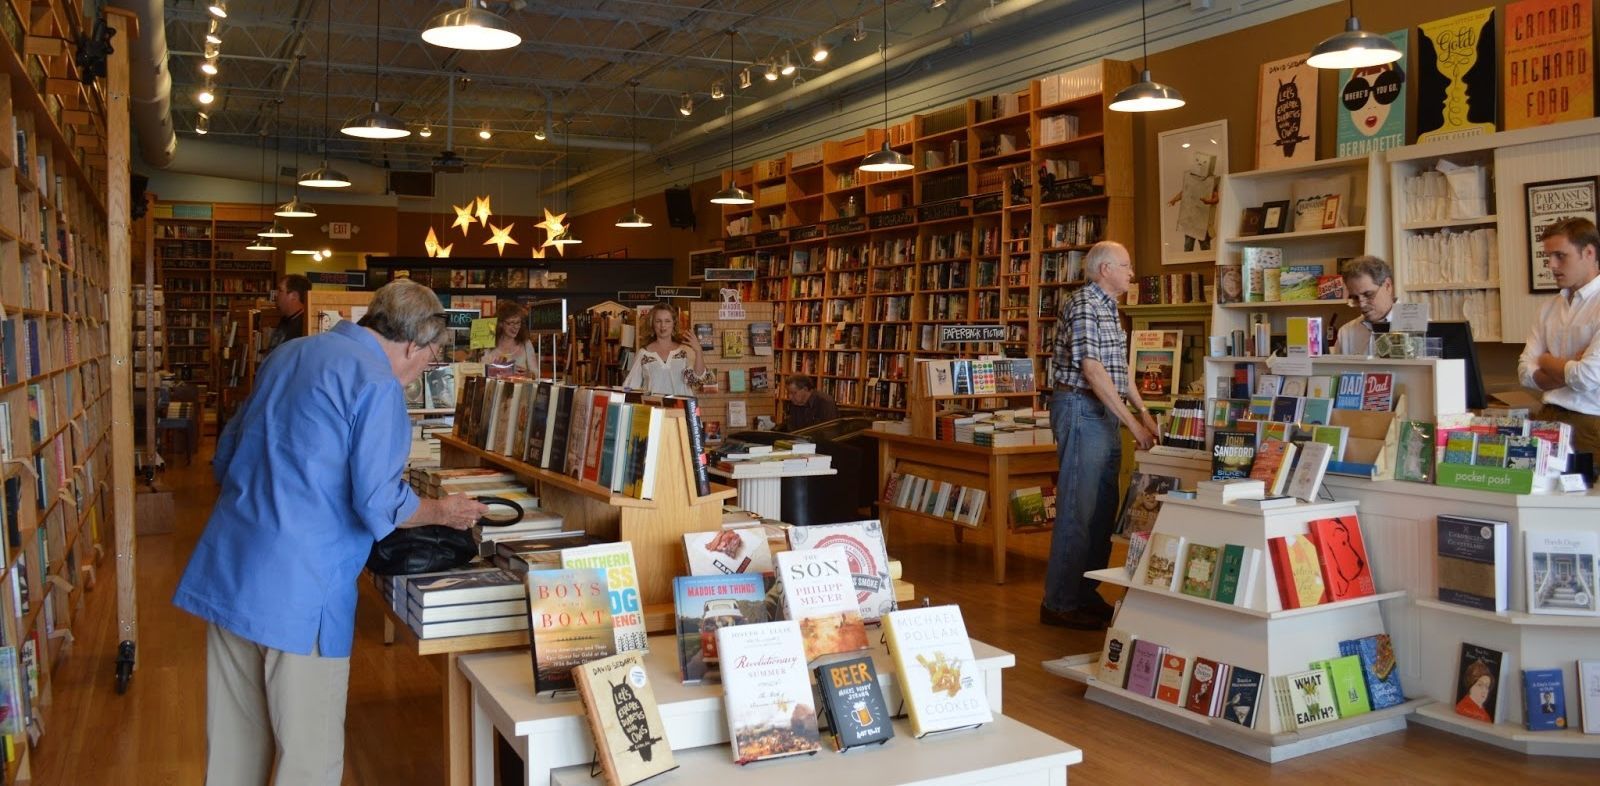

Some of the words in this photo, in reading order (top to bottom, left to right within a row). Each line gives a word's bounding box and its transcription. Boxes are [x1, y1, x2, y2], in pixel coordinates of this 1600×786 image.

[1514, 2, 1581, 41] CANADA
[1437, 26, 1476, 62] Gold
[1510, 48, 1587, 87] RICHARD
[1376, 85, 1388, 95] YOU
[1526, 87, 1569, 118] FORD
[1339, 134, 1402, 158] BERNADETTE
[1536, 189, 1589, 205] PARNASSUS
[1542, 200, 1584, 211] BOOKS
[333, 224, 347, 234] EXIT
[943, 327, 982, 340] PAPERBACK
[983, 327, 1005, 339] FICTION
[1340, 375, 1363, 395] DAD
[1366, 375, 1389, 394] Dad
[1225, 435, 1245, 446] JOHN
[1214, 444, 1254, 457] SANDFORD
[1455, 471, 1486, 484] pocket
[1487, 474, 1511, 486] posh
[566, 552, 630, 569] SOUTHERN
[790, 560, 840, 580] SON
[538, 582, 602, 599] BOYS
[687, 584, 715, 598] MADDIE
[717, 584, 727, 595] ON
[729, 582, 756, 595] THINGS
[796, 583, 843, 596] PHILIPP
[857, 576, 879, 589] SMOKE
[608, 588, 639, 615] OG
[800, 593, 843, 606] MEYER
[542, 609, 605, 628] BOAT
[897, 613, 959, 627] MICHAEL
[904, 628, 960, 641] POLLAN
[592, 664, 612, 676] DAVID
[612, 656, 637, 671] SEDARIS
[830, 662, 872, 688] BEER
[1294, 674, 1321, 690] WHAT
[618, 701, 640, 719] EXPLORE
[925, 699, 979, 715] COOKED
[1296, 706, 1335, 725] EARTH?
